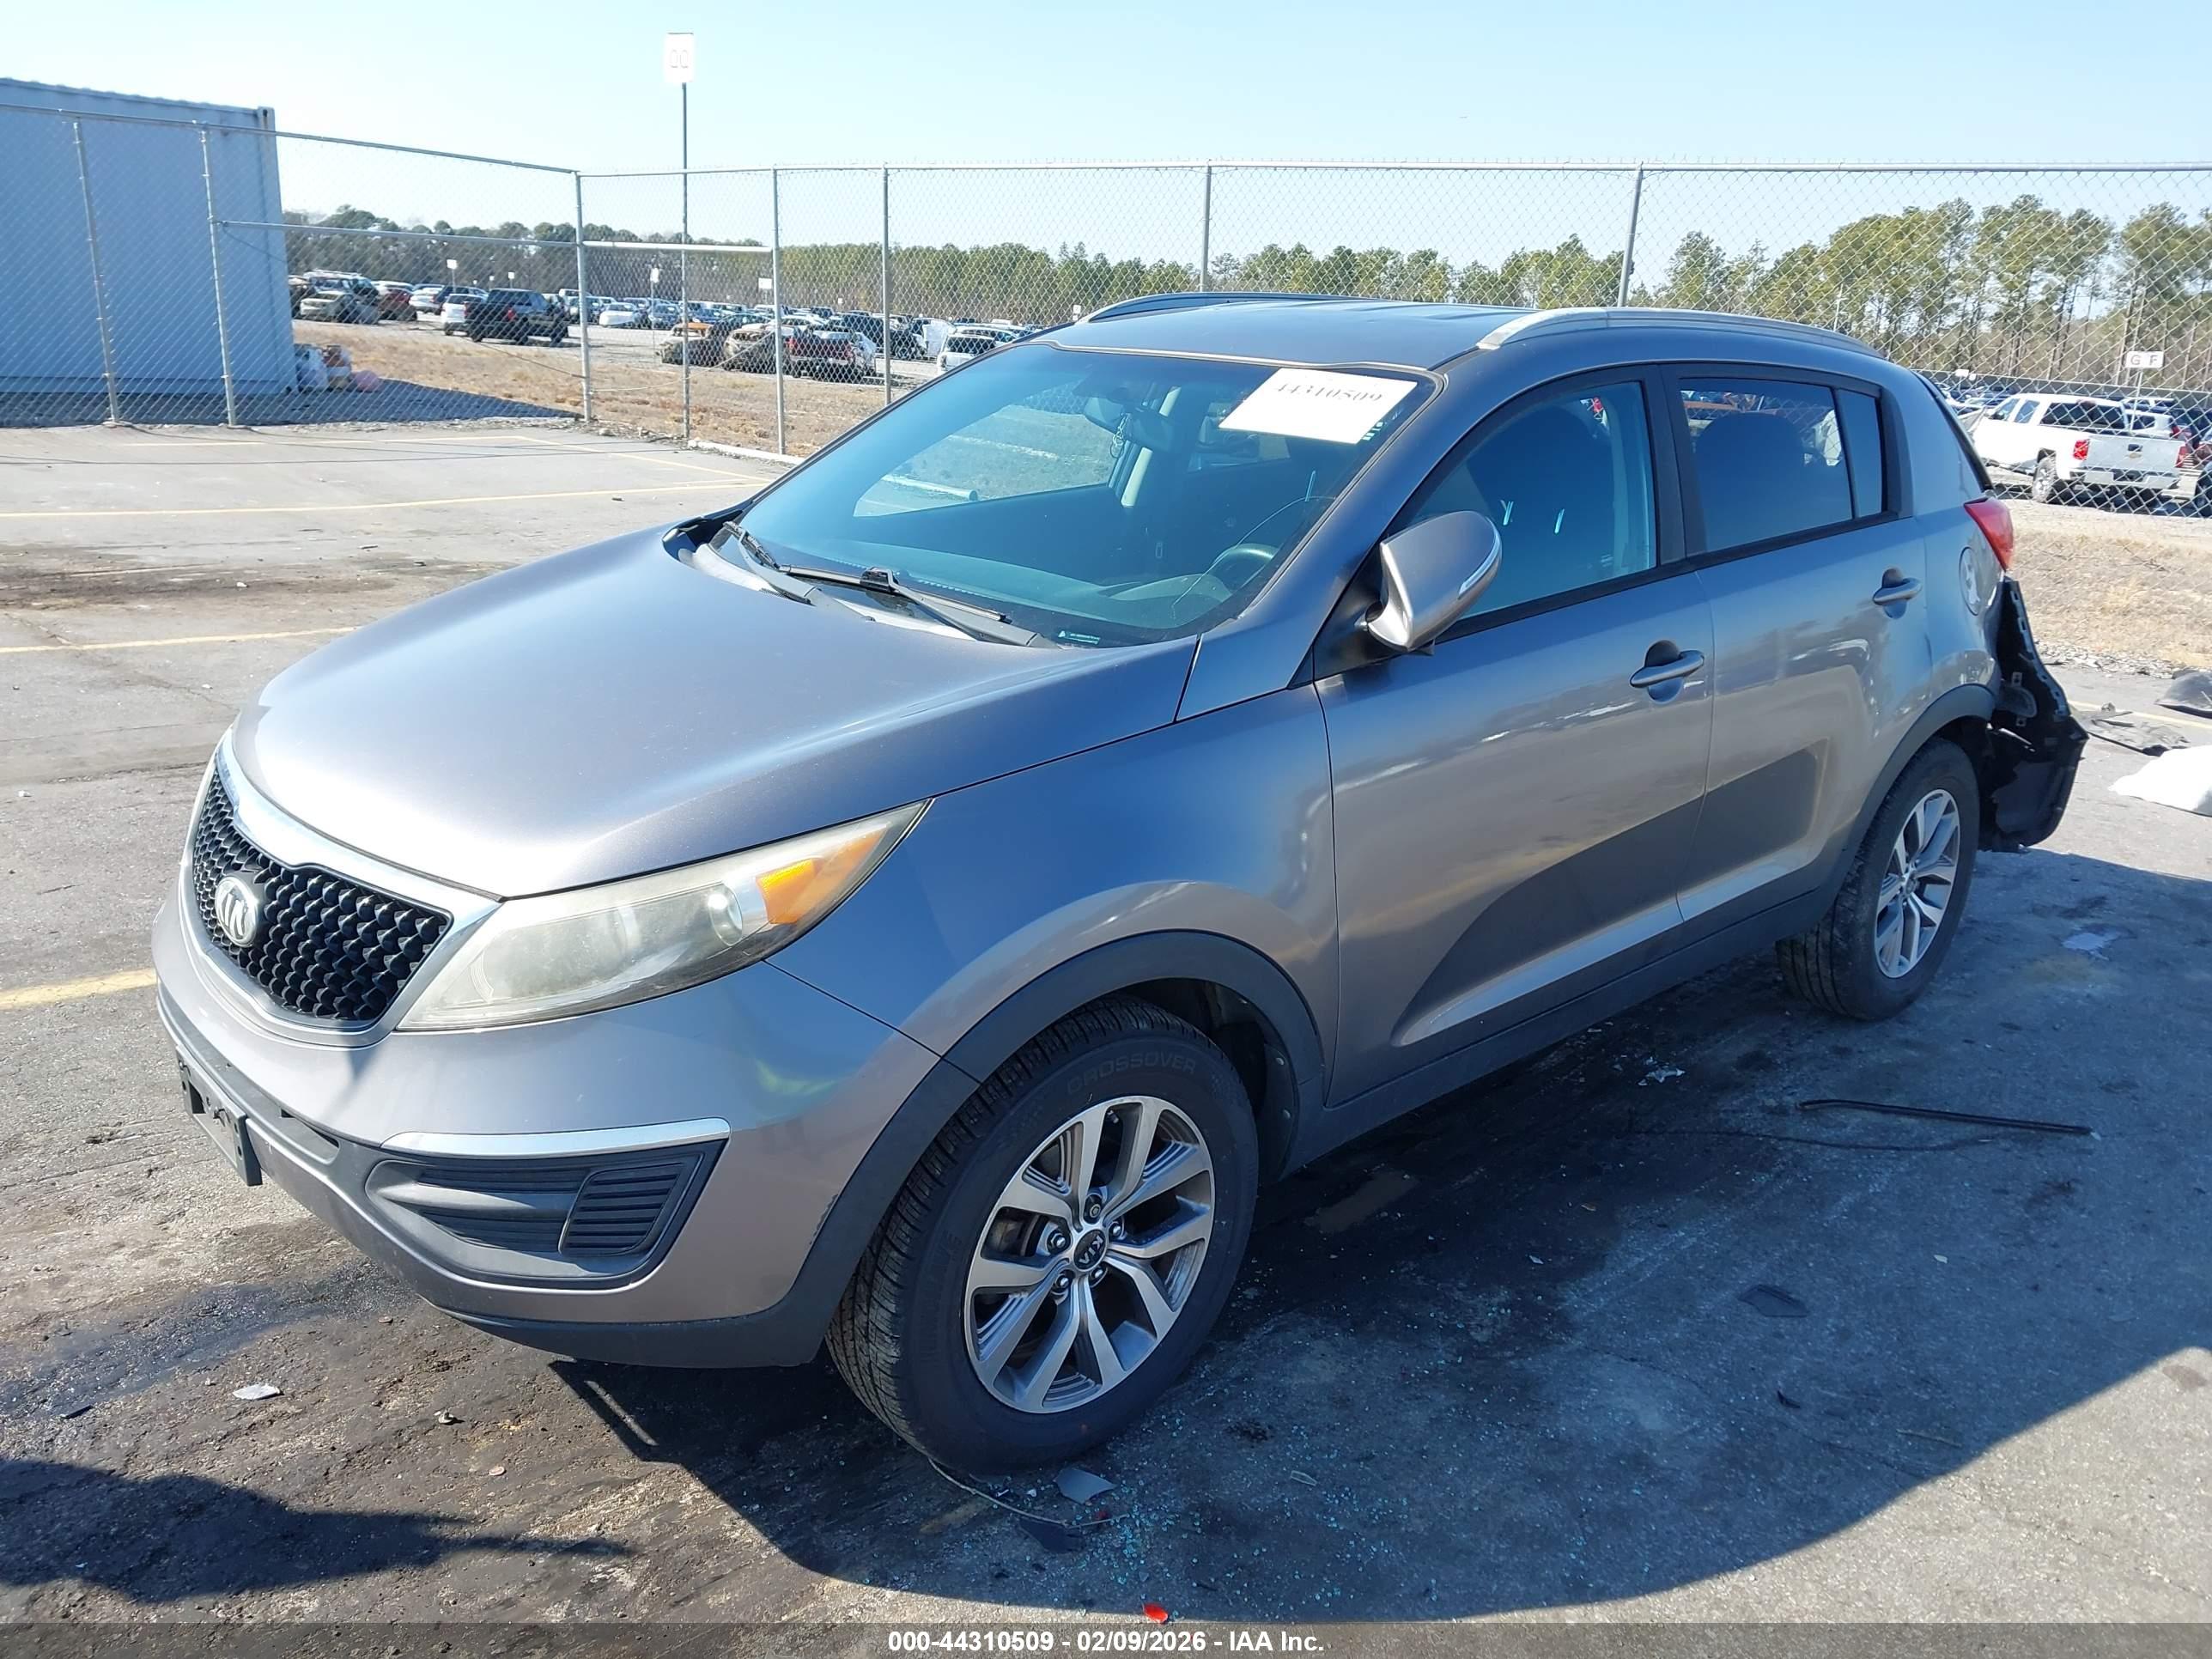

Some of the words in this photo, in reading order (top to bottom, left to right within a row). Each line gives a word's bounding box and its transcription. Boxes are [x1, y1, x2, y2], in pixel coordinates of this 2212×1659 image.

[2130, 354, 2142, 366] G
[1066, 1050, 1197, 1095] CROSSOVER
[1079, 1235, 1103, 1263] KIA
